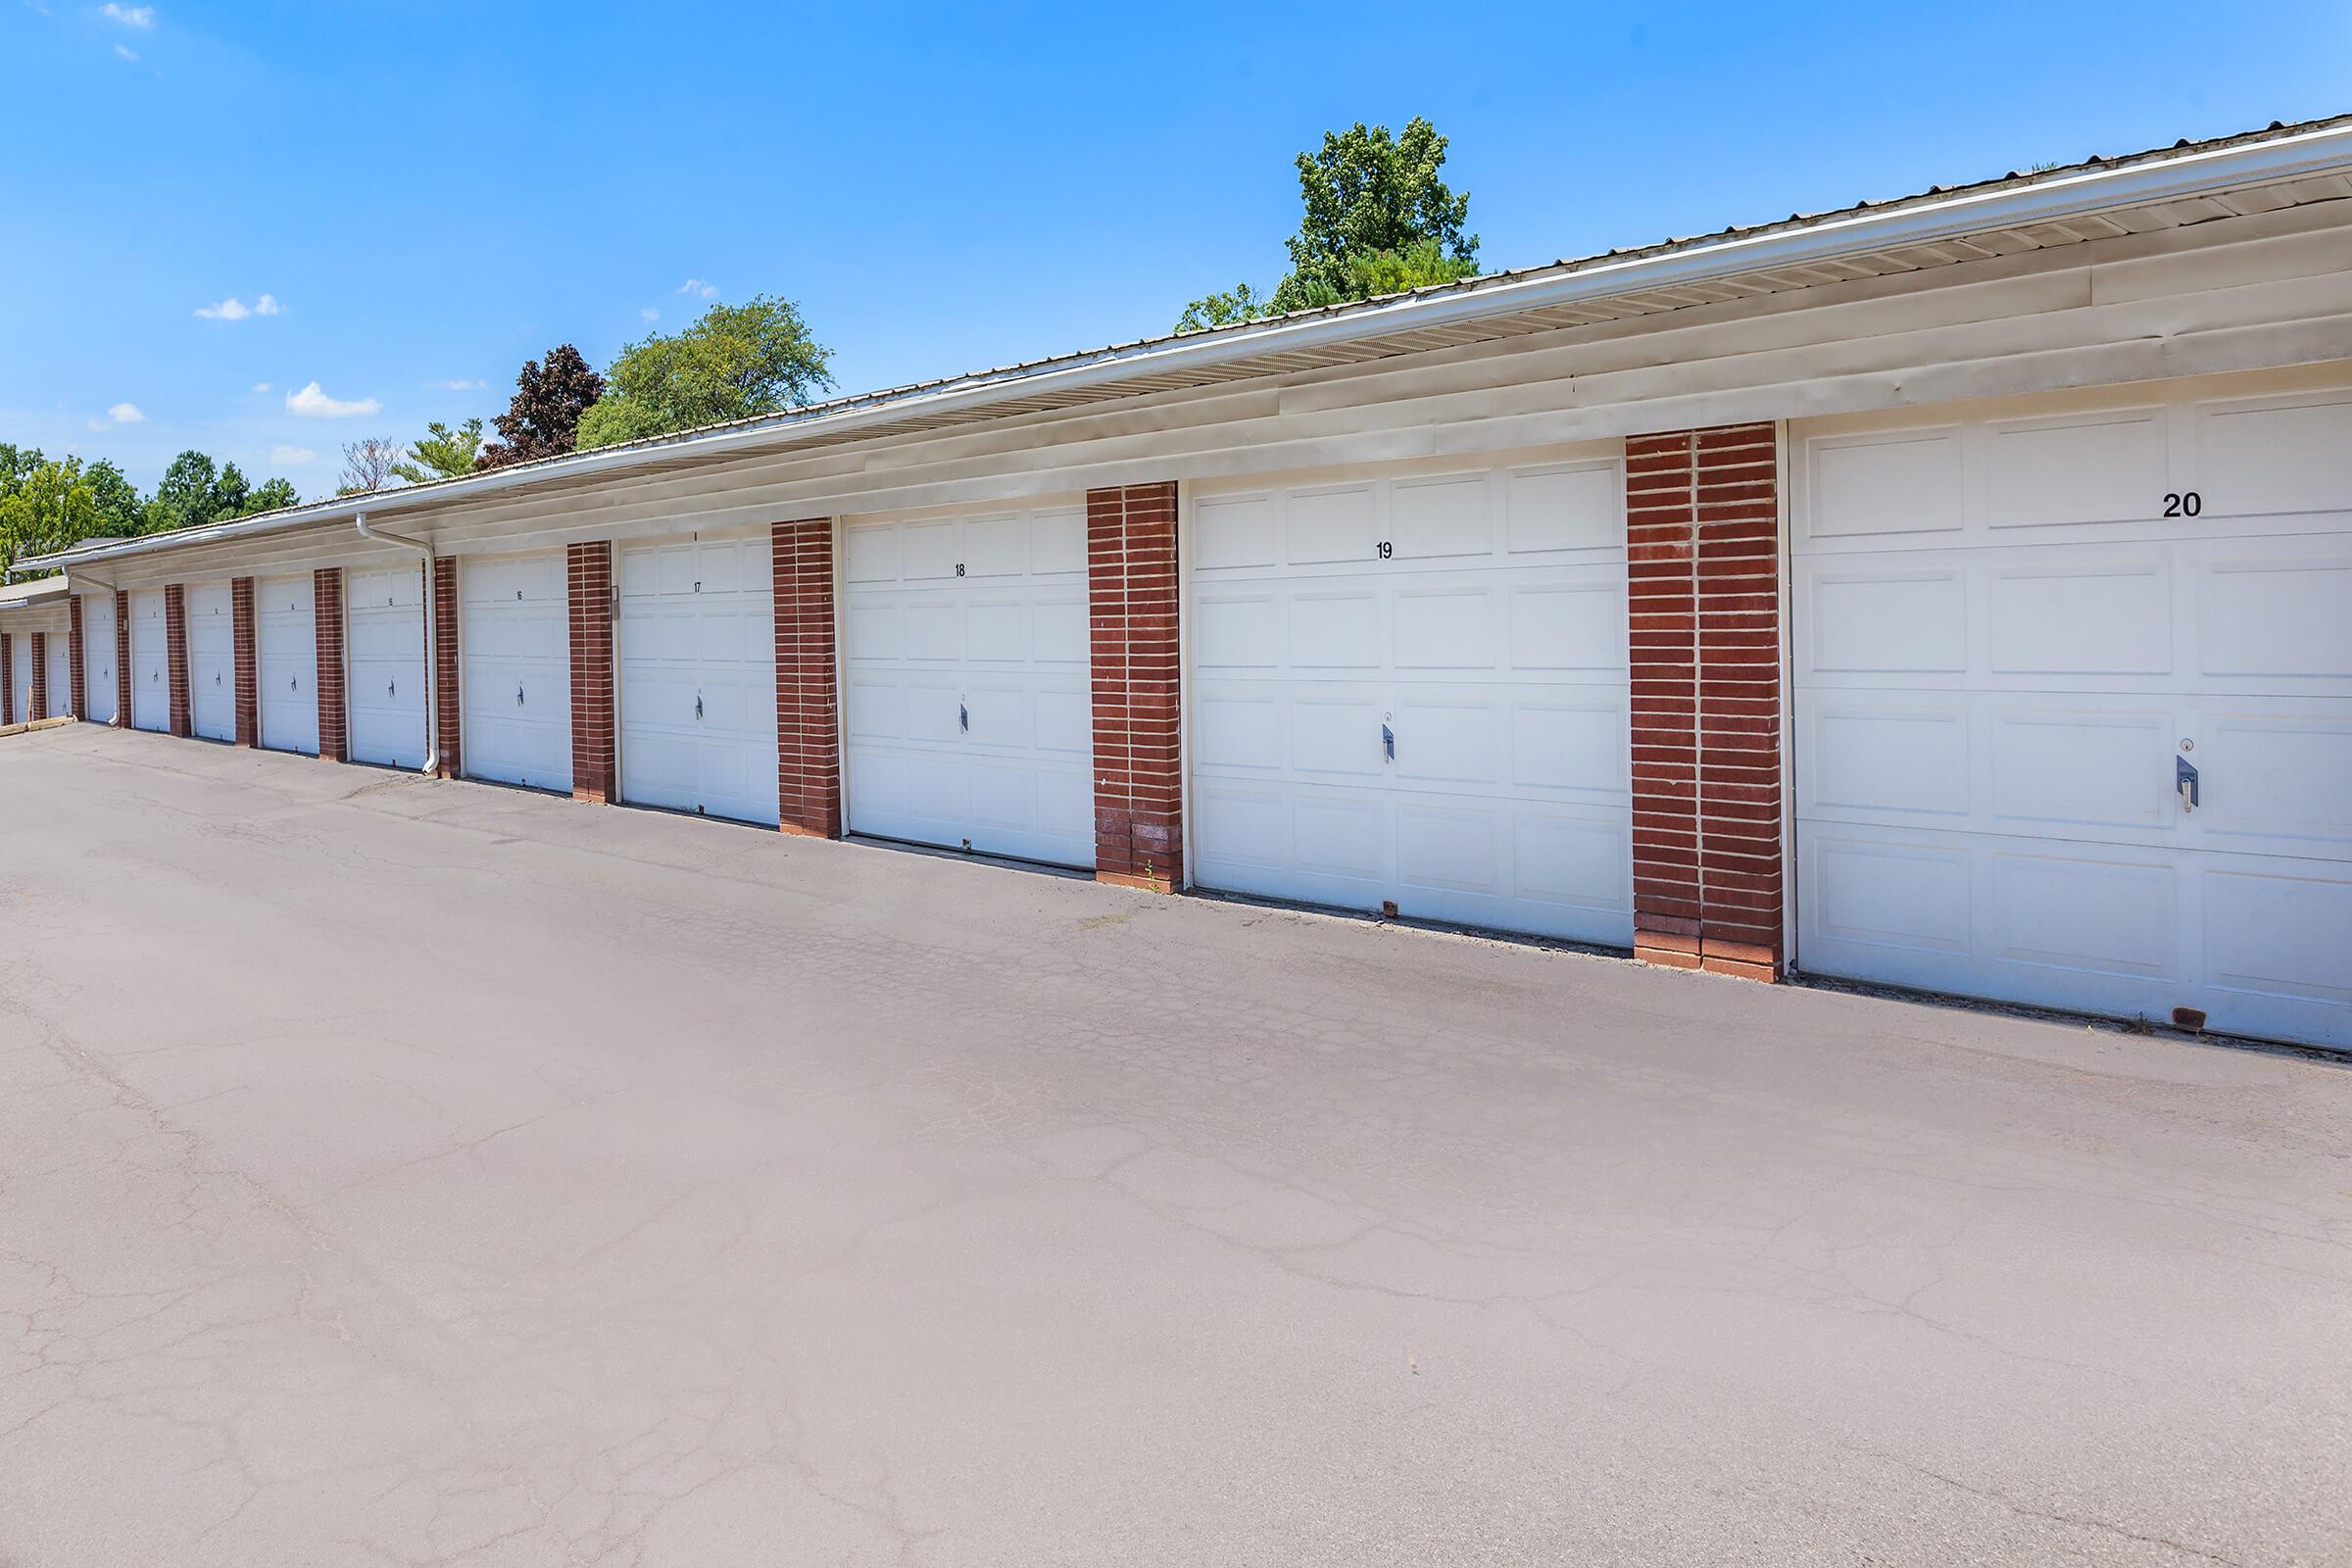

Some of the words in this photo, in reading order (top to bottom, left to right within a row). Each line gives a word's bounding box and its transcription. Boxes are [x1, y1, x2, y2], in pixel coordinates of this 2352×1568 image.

[2163, 492, 2201, 517] 20
[1376, 541, 1393, 560] 19
[955, 563, 965, 577] 18
[694, 581, 701, 593] 17
